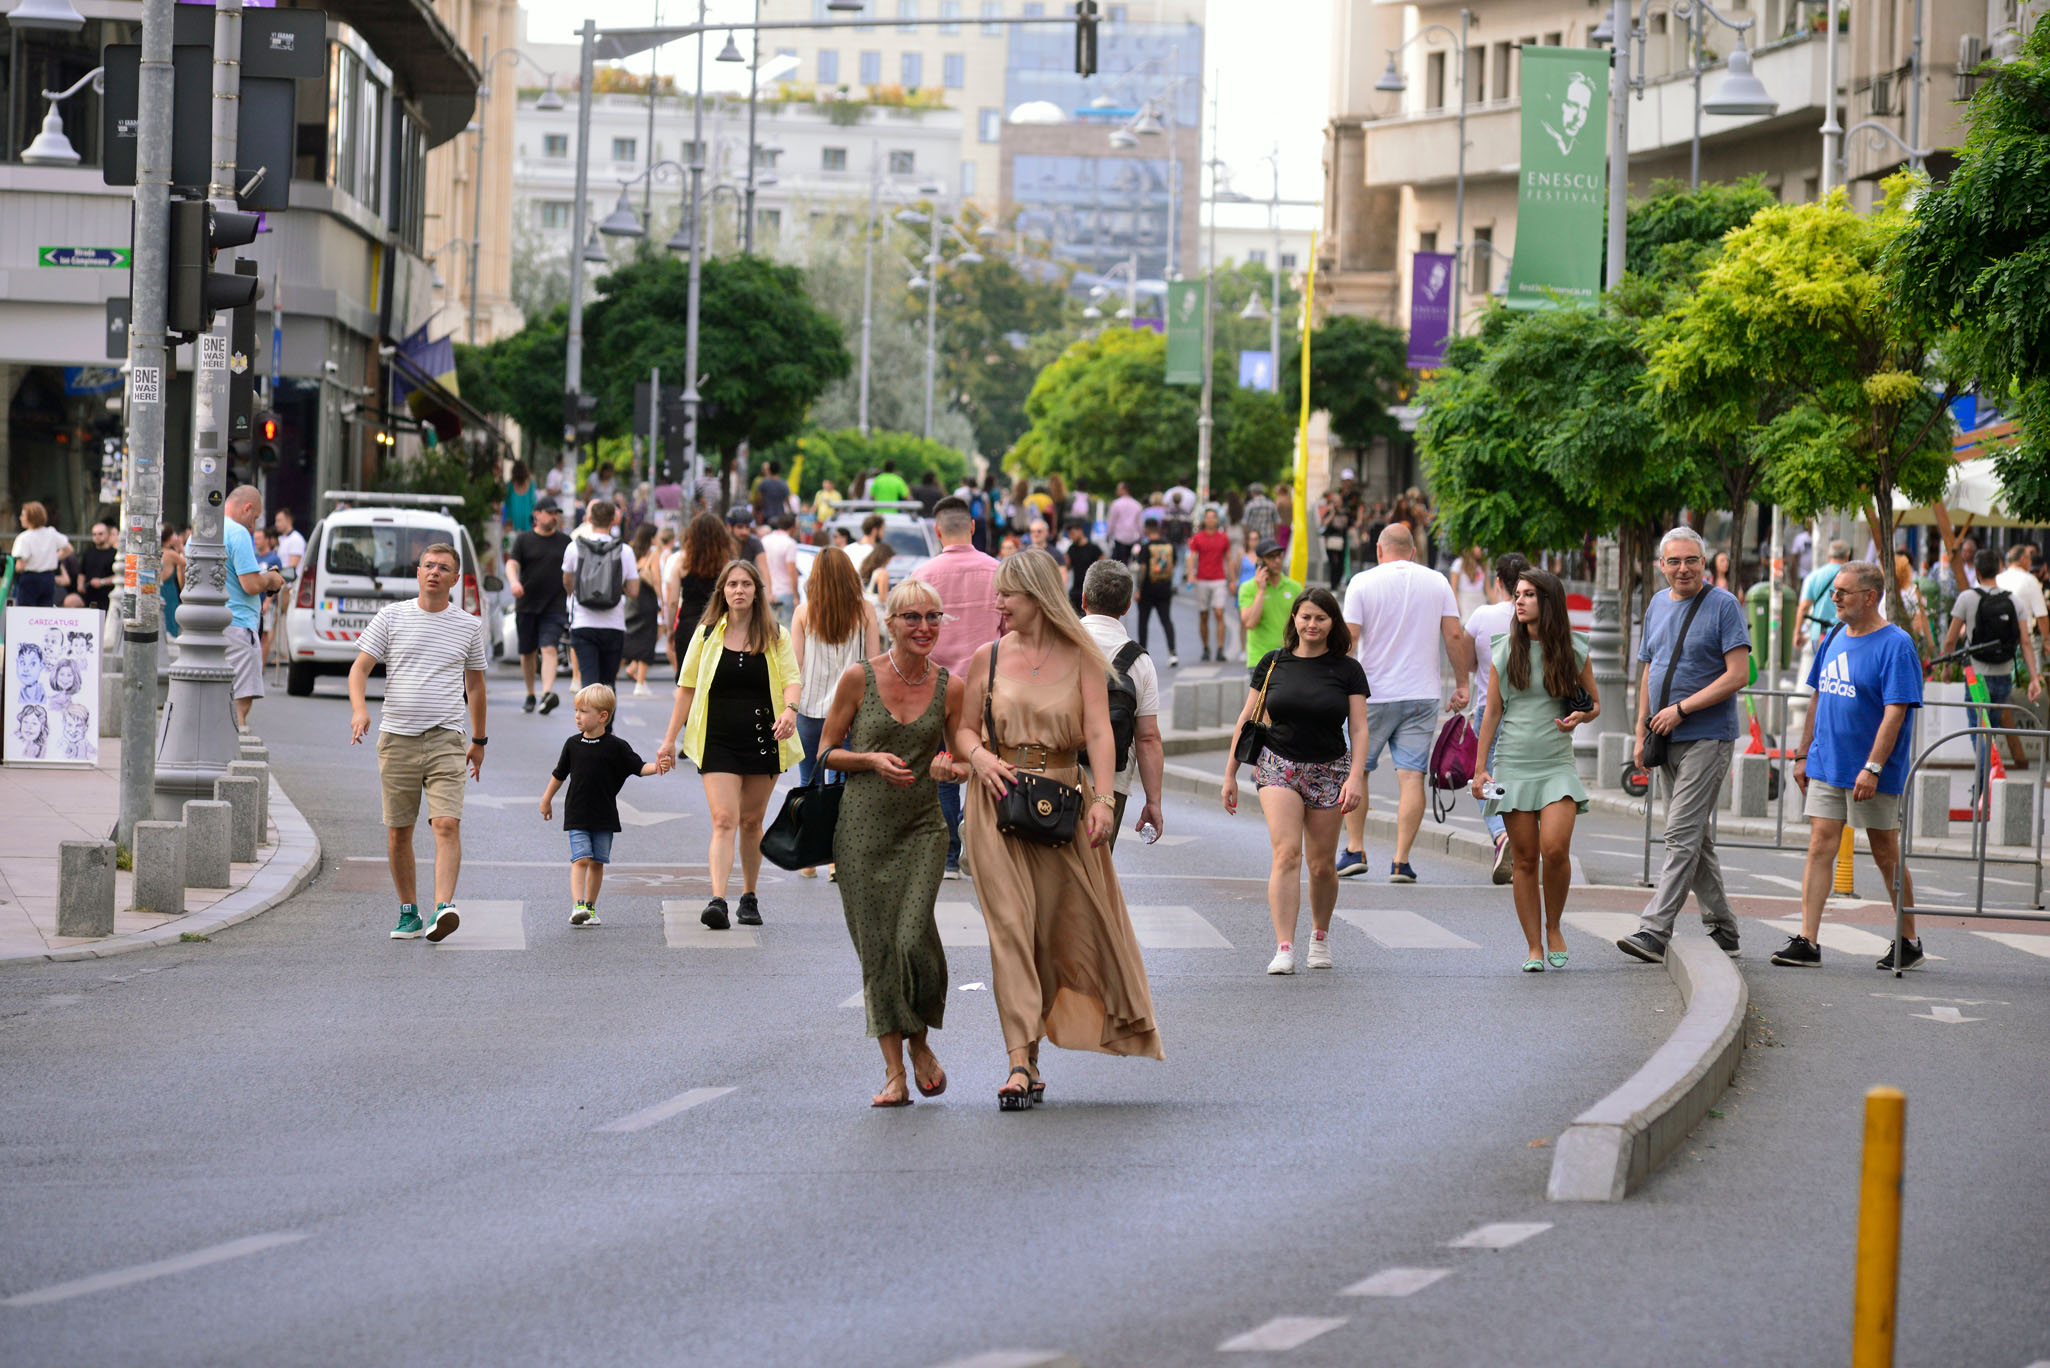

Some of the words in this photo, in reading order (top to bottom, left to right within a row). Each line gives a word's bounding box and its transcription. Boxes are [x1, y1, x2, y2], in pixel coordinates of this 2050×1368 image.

[1527, 171, 1599, 189] ENESCU
[1527, 189, 1597, 204] FESTIVAL
[203, 337, 225, 352] BNE
[203, 352, 225, 360] WAS
[202, 360, 225, 368] HERE
[135, 369, 158, 384] BNE
[135, 384, 157, 393] WAS
[134, 393, 157, 401] HERE
[28, 617, 79, 627] CARICATURI
[331, 617, 369, 628] POLITI
[1818, 676, 1857, 698] didas
